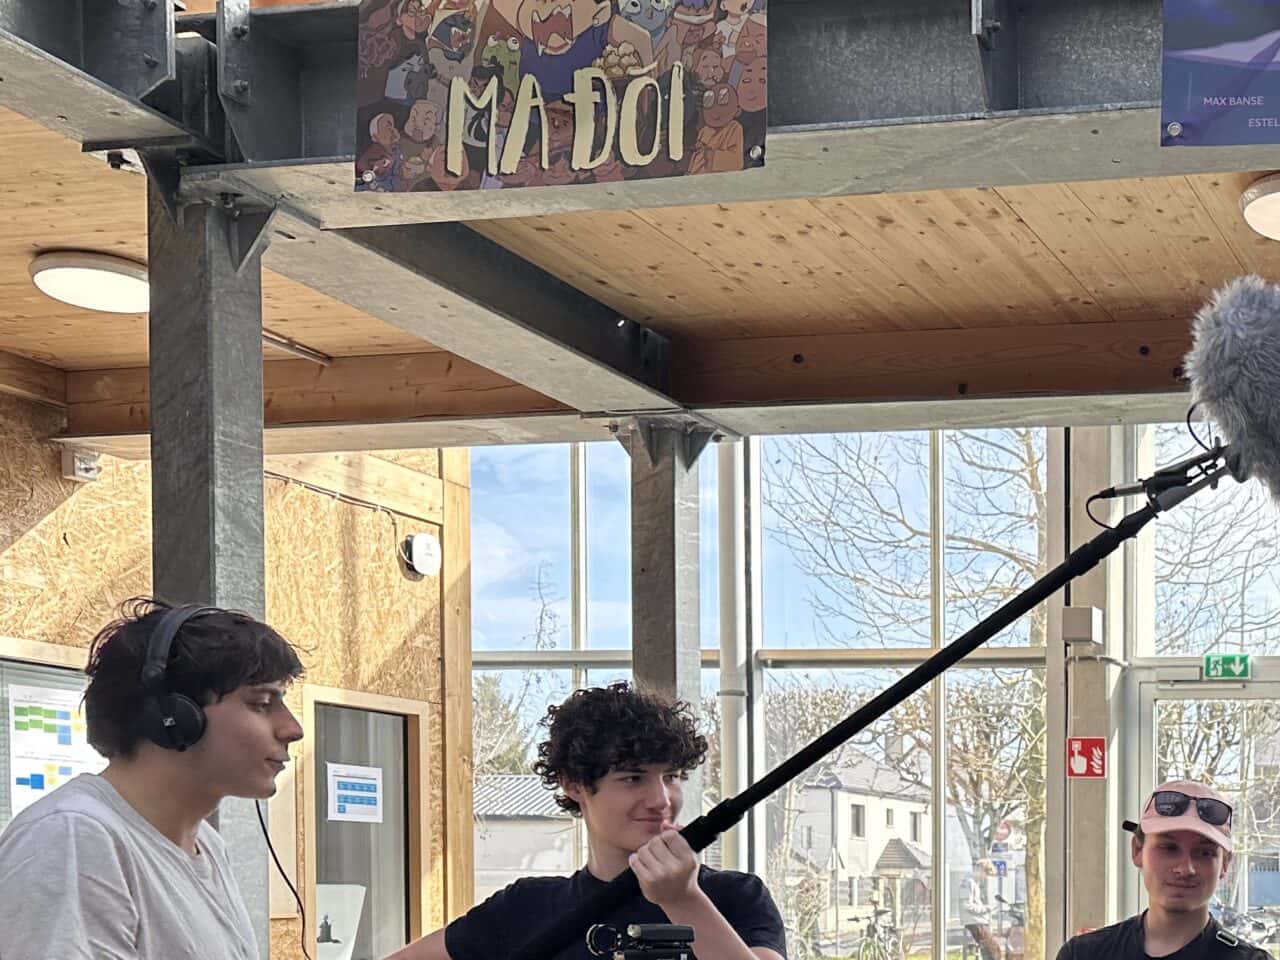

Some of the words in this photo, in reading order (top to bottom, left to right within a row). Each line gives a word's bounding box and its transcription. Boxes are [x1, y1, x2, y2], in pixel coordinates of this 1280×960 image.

[445, 74, 549, 177] MA
[1203, 97, 1227, 106] MAX
[1229, 95, 1265, 106] BANSE
